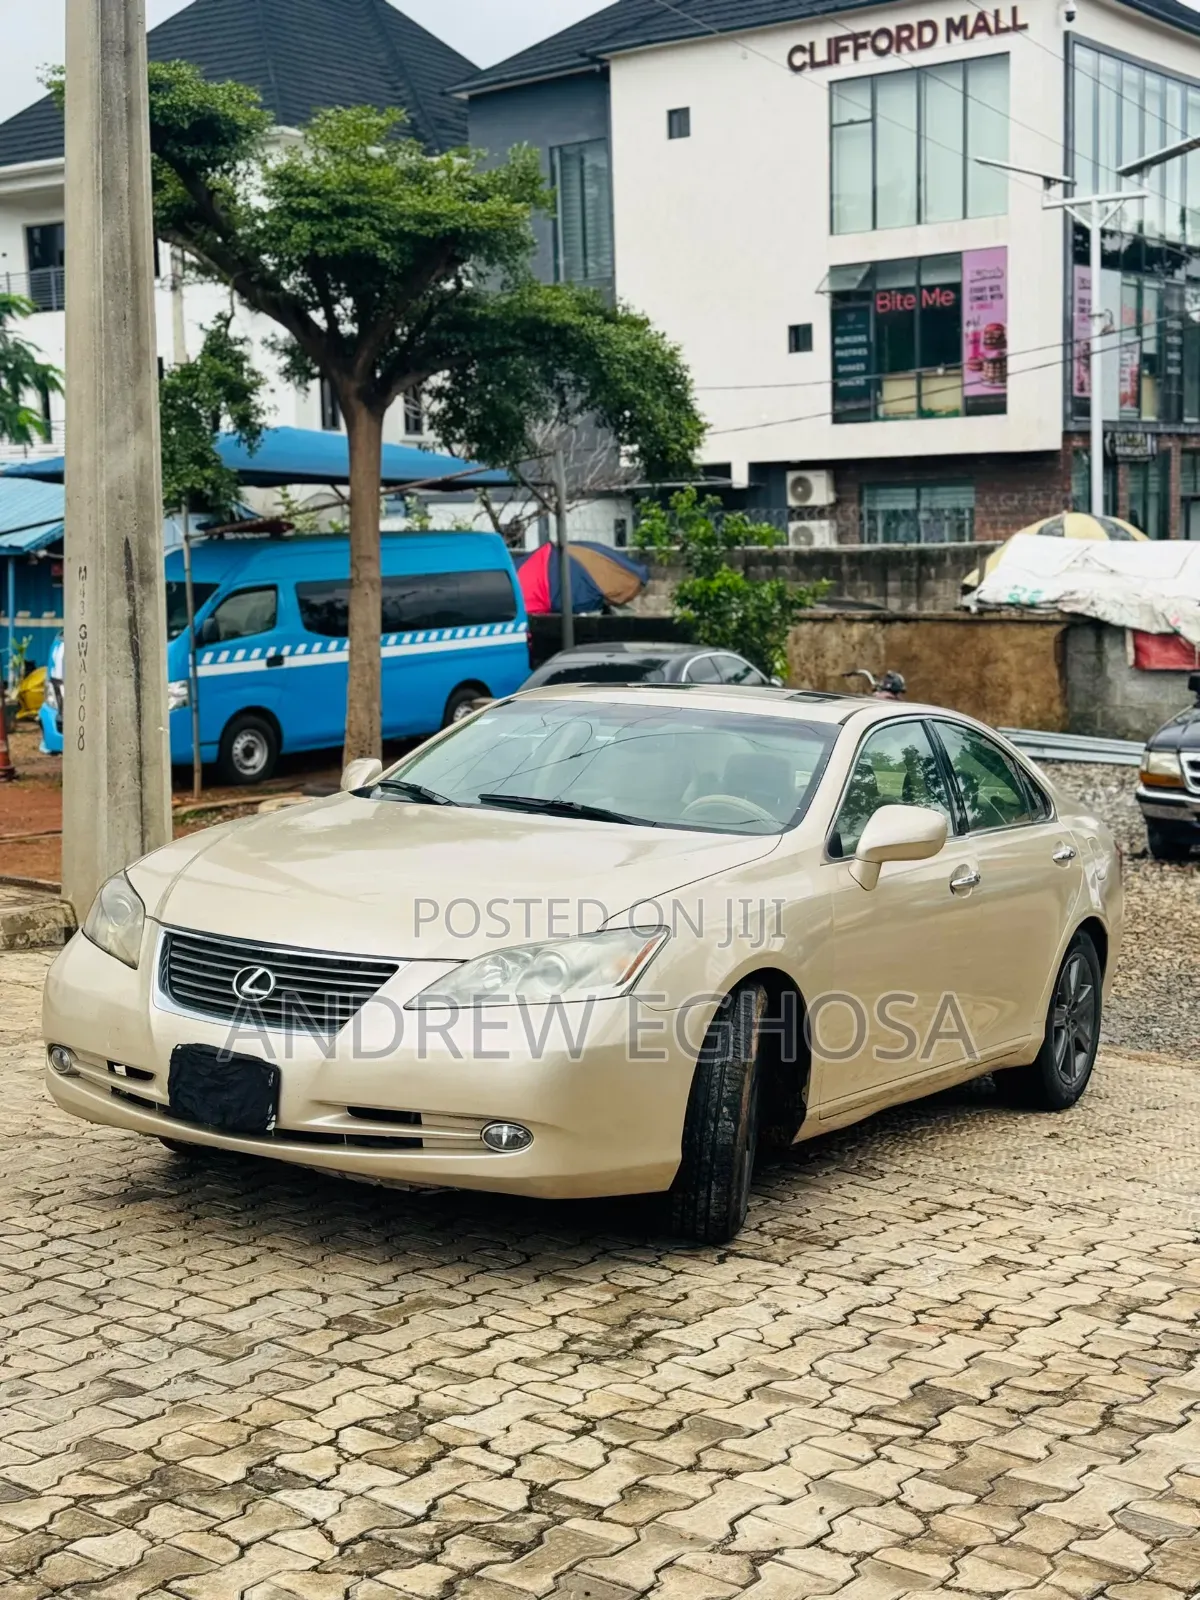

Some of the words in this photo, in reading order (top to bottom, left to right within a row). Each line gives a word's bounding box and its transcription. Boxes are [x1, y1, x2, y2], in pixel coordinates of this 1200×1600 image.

[787, 19, 938, 73] CLIFFORD
[945, 5, 1029, 44] MALL
[875, 291, 916, 313] Bite
[921, 287, 955, 309] Me
